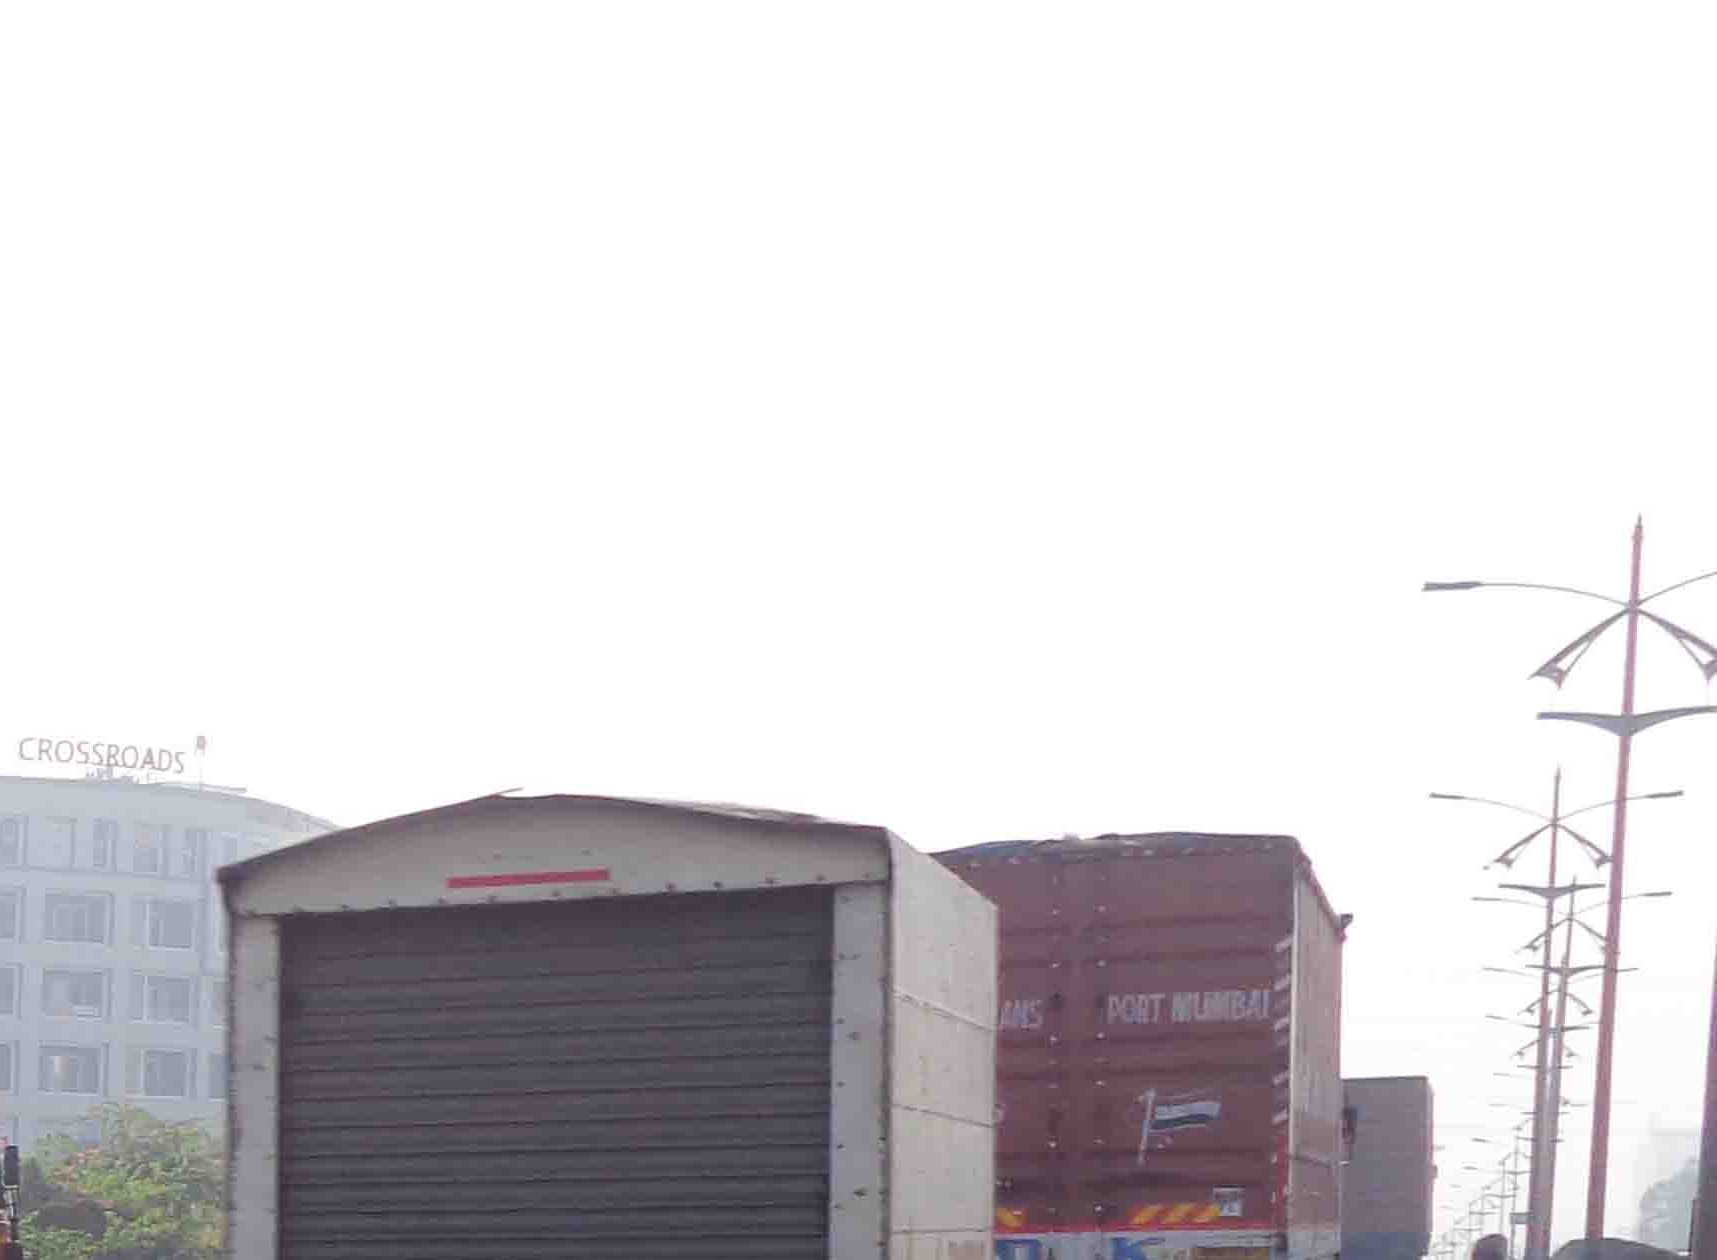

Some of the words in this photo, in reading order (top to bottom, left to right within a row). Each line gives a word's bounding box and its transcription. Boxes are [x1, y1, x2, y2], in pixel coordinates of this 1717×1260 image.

[17, 735, 186, 775] CROSSROADS
[1107, 992, 1165, 1025] PORT
[1171, 988, 1270, 1024] MUMBAI
